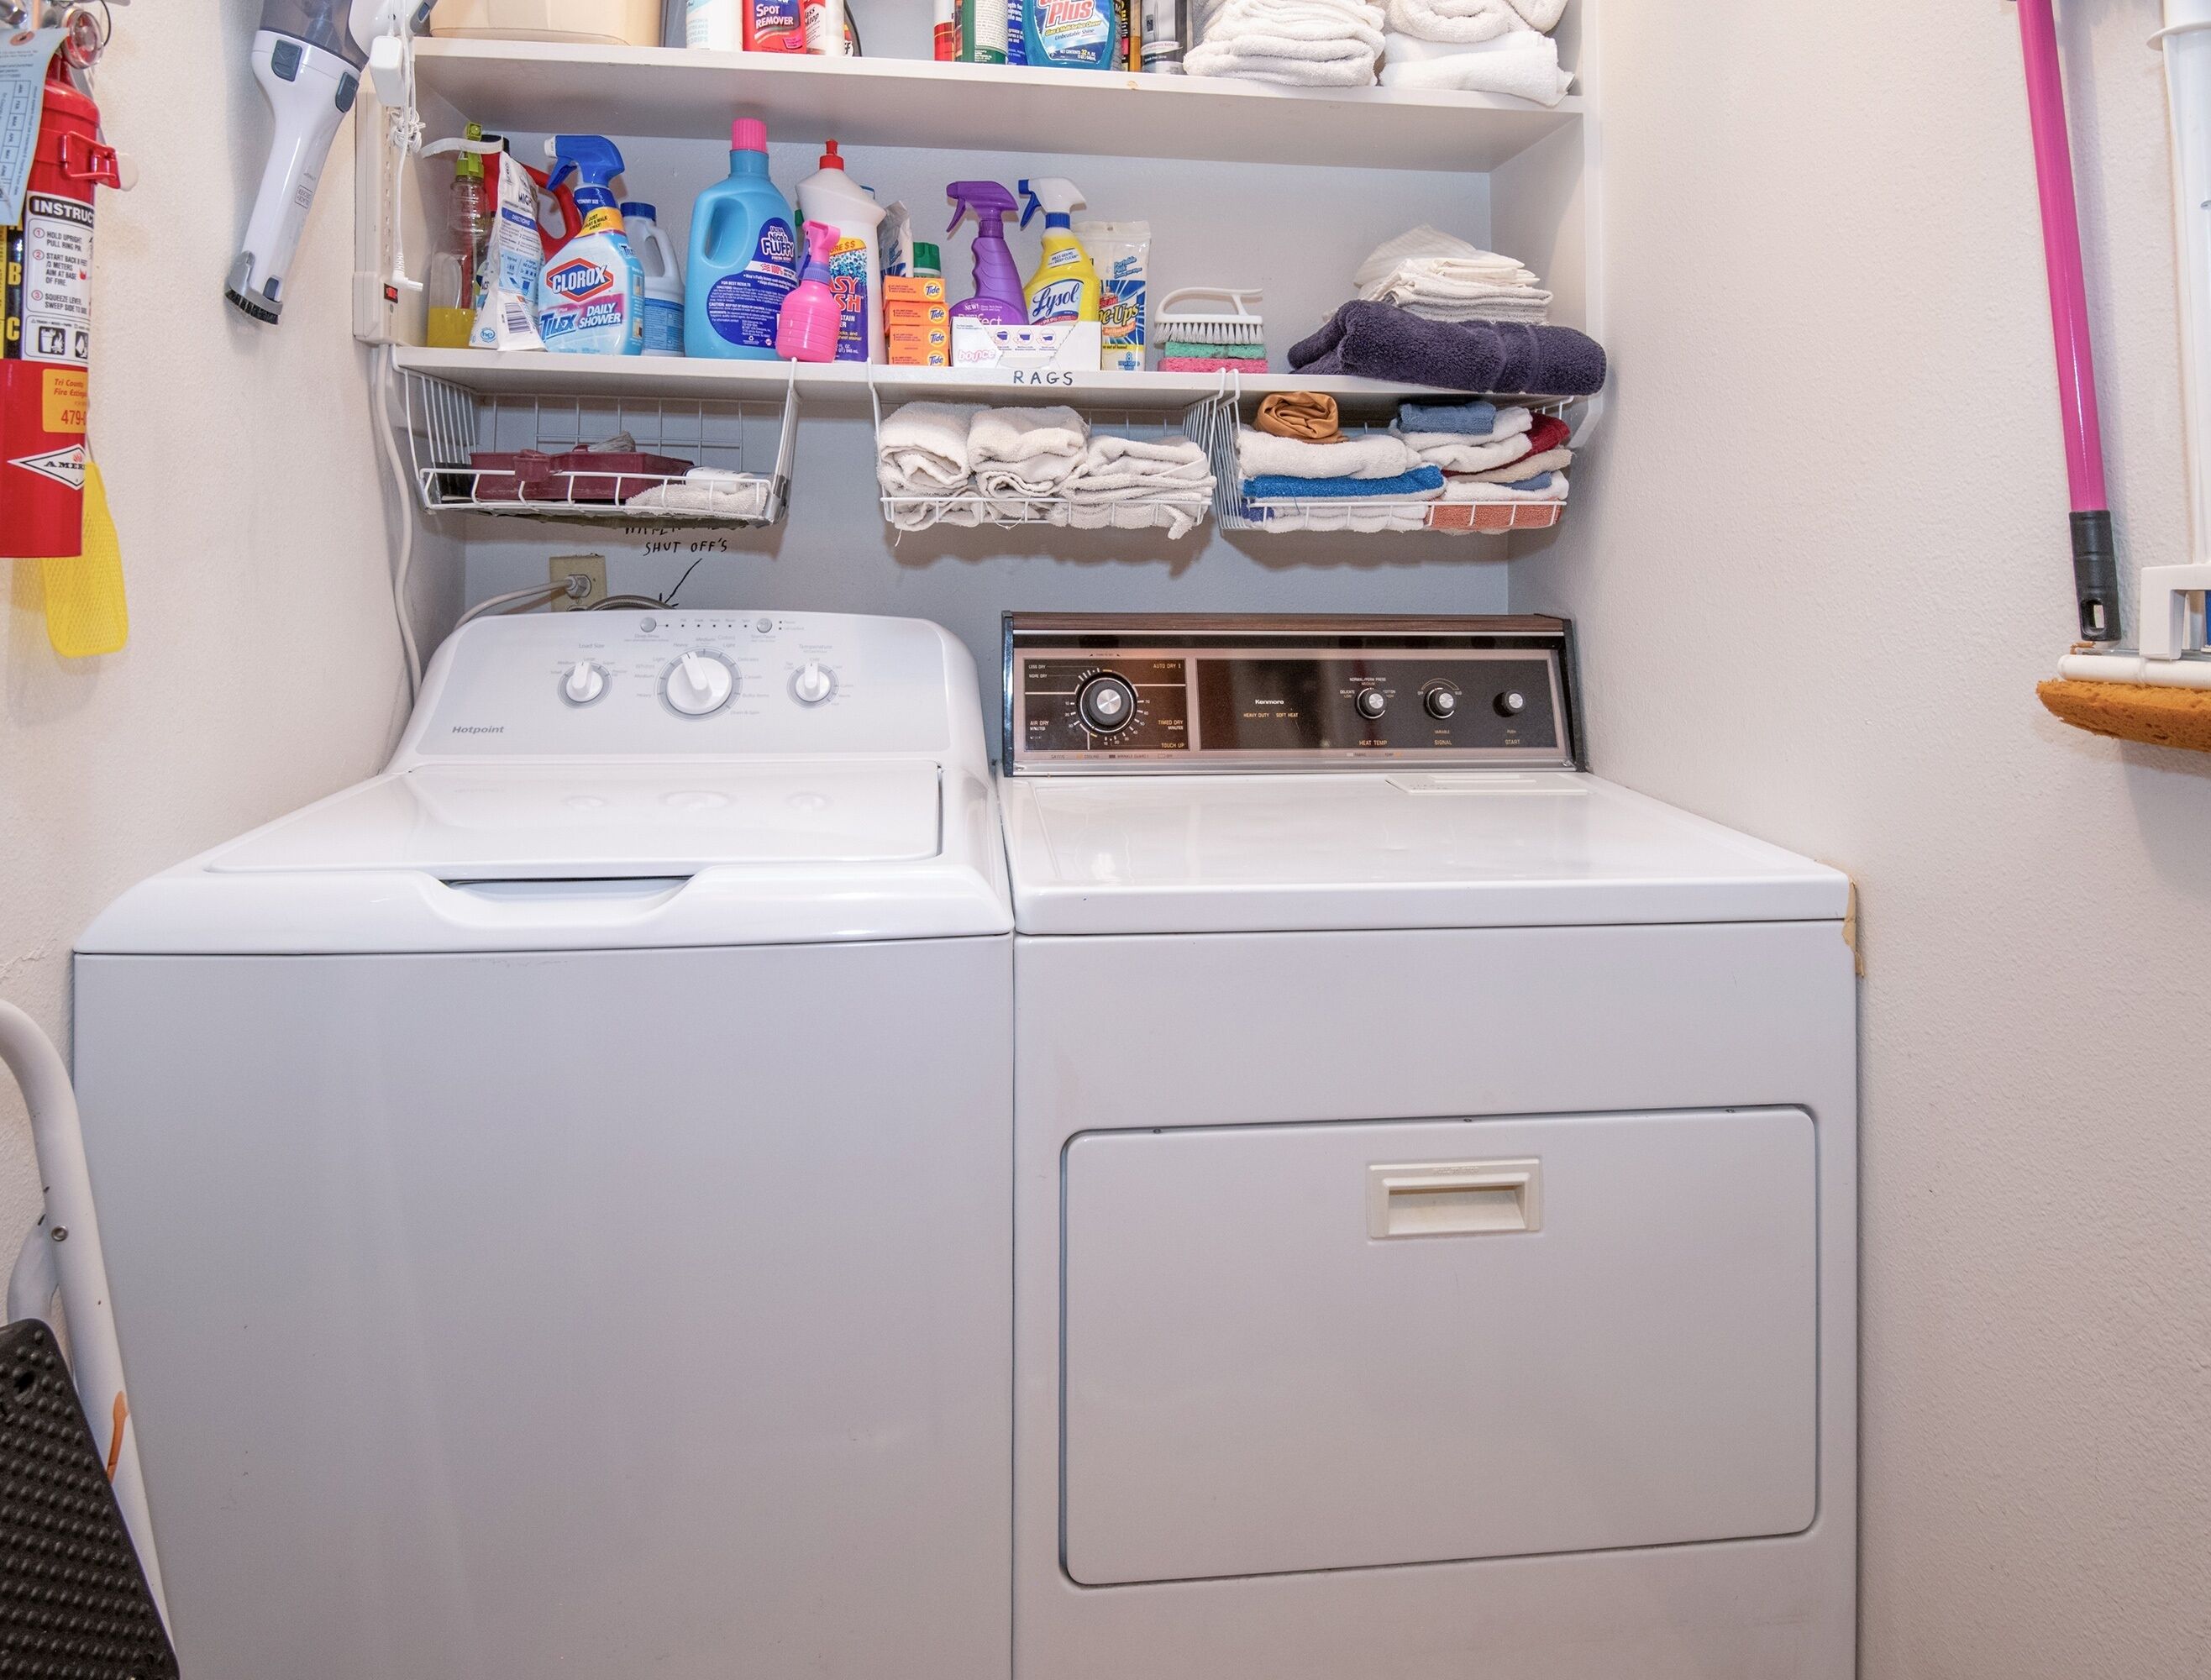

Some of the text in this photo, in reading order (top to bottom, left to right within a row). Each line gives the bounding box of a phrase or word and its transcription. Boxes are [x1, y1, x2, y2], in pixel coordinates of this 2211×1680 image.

[756, 3, 780, 17] SPOT
[1048, 0, 1093, 25] Plus
[756, 17, 793, 29] REMOVER
[597, 215, 608, 223] WALK
[47, 231, 62, 240] HOLD
[46, 239, 73, 251] PULL RING
[762, 239, 794, 256] FLUFFY
[46, 252, 63, 261] START
[65, 255, 76, 264] BACK
[53, 262, 73, 271] METERS
[8, 261, 22, 285] B
[553, 264, 607, 294] CLOROX
[926, 286, 940, 296] Tide
[45, 293, 68, 303] SQUEEZE
[1032, 282, 1080, 317] Lysol
[45, 302, 64, 311] SWEEP
[65, 305, 75, 313] SIDE
[587, 302, 616, 317] DAILY
[930, 309, 944, 319] Tide
[579, 312, 622, 329] SHOWER
[7, 317, 20, 341] C
[930, 333, 944, 343] Tide
[929, 355, 943, 365] Tide
[958, 349, 997, 363] bounce
[1127, 352, 1133, 362] 8
[54, 378, 64, 386] Tri
[1013, 370, 1074, 386] RAGS
[53, 388, 68, 396] Fire
[643, 538, 727, 556] SHUT OFF'S
[452, 725, 504, 734] Hotpoint
